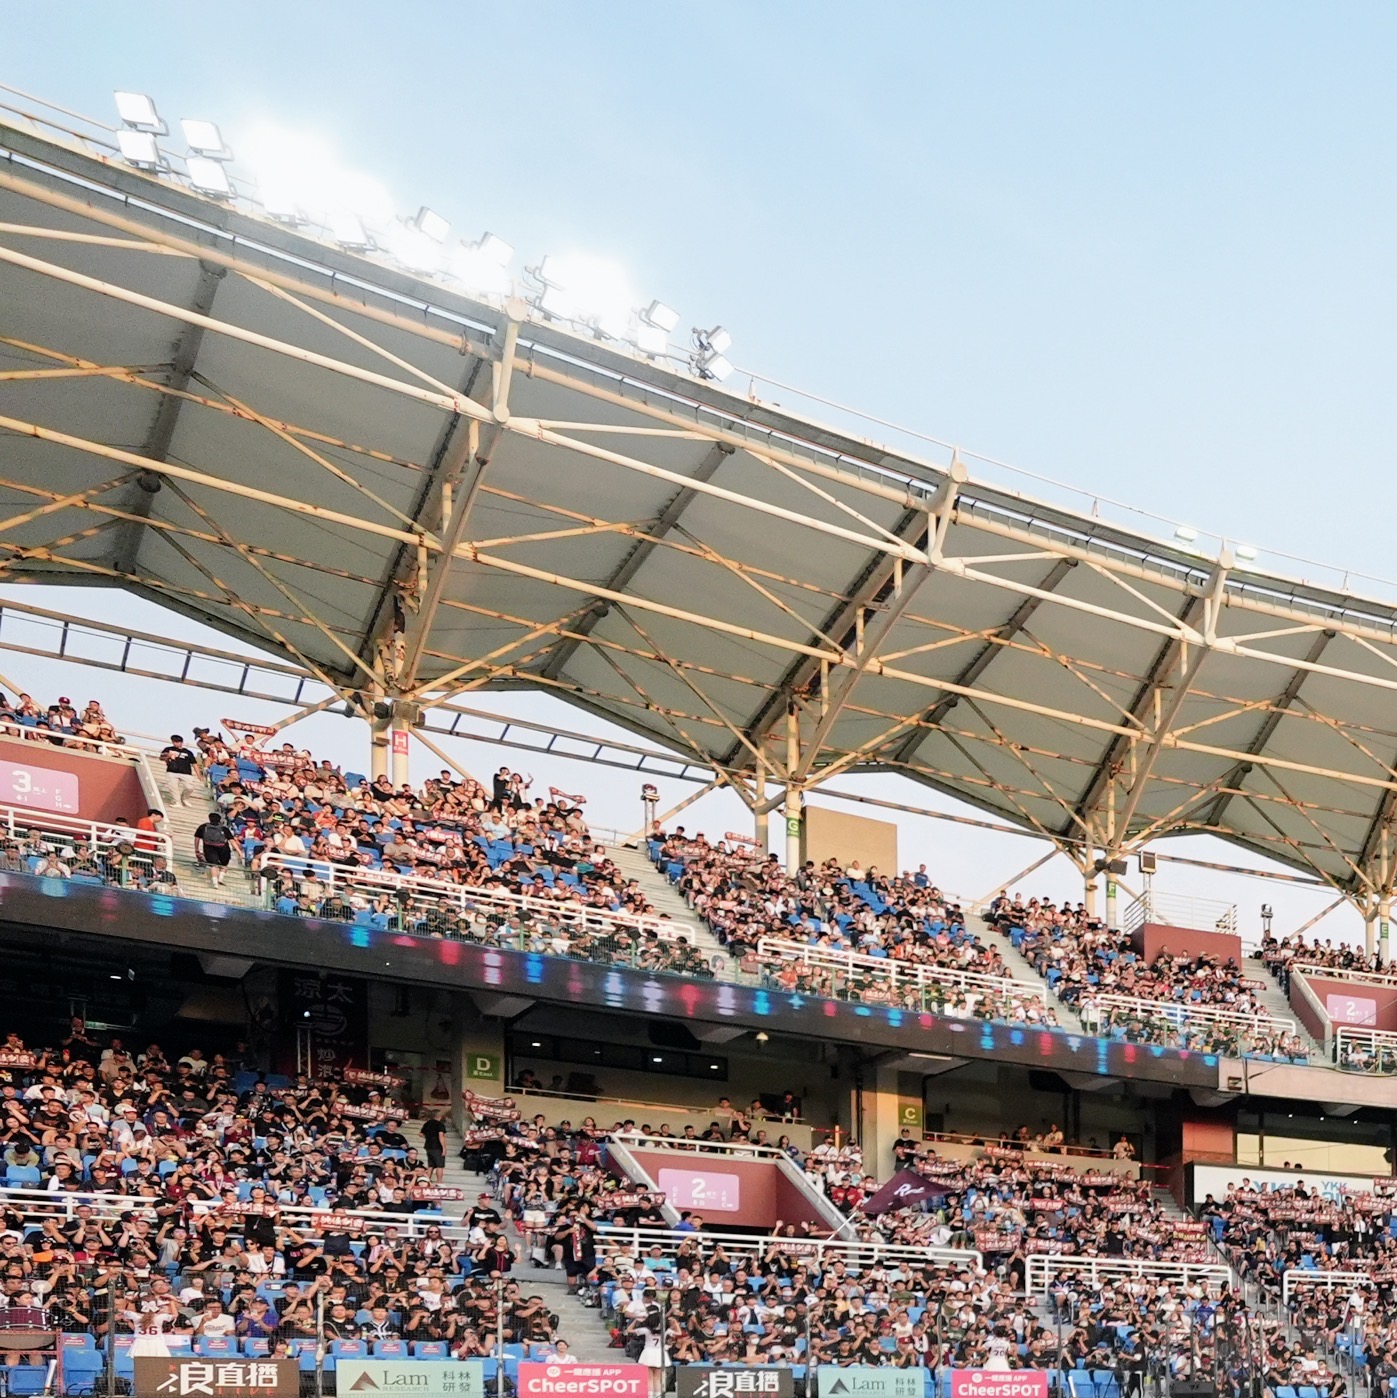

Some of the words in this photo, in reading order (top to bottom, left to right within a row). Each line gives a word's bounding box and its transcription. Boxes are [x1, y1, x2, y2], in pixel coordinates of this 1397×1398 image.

[394, 733, 407, 746] H
[11, 770, 31, 792] 3
[788, 820, 798, 831] G
[1346, 1001, 1355, 1016] 2
[476, 1058, 491, 1071] D
[905, 1108, 916, 1119] C
[691, 1178, 705, 1198] 2
[139, 1326, 158, 1336] 36
[651, 1338, 659, 1347] 7
[156, 1362, 278, 1395] 浪直播
[443, 1371, 471, 1380] 科林
[603, 1368, 621, 1376] APP
[382, 1371, 429, 1387] Lam
[693, 1370, 779, 1398] 浪直播
[852, 1377, 885, 1390] Lam
[527, 1378, 640, 1394] CheerSPOT
[958, 1383, 1041, 1397] CheerSPOT
